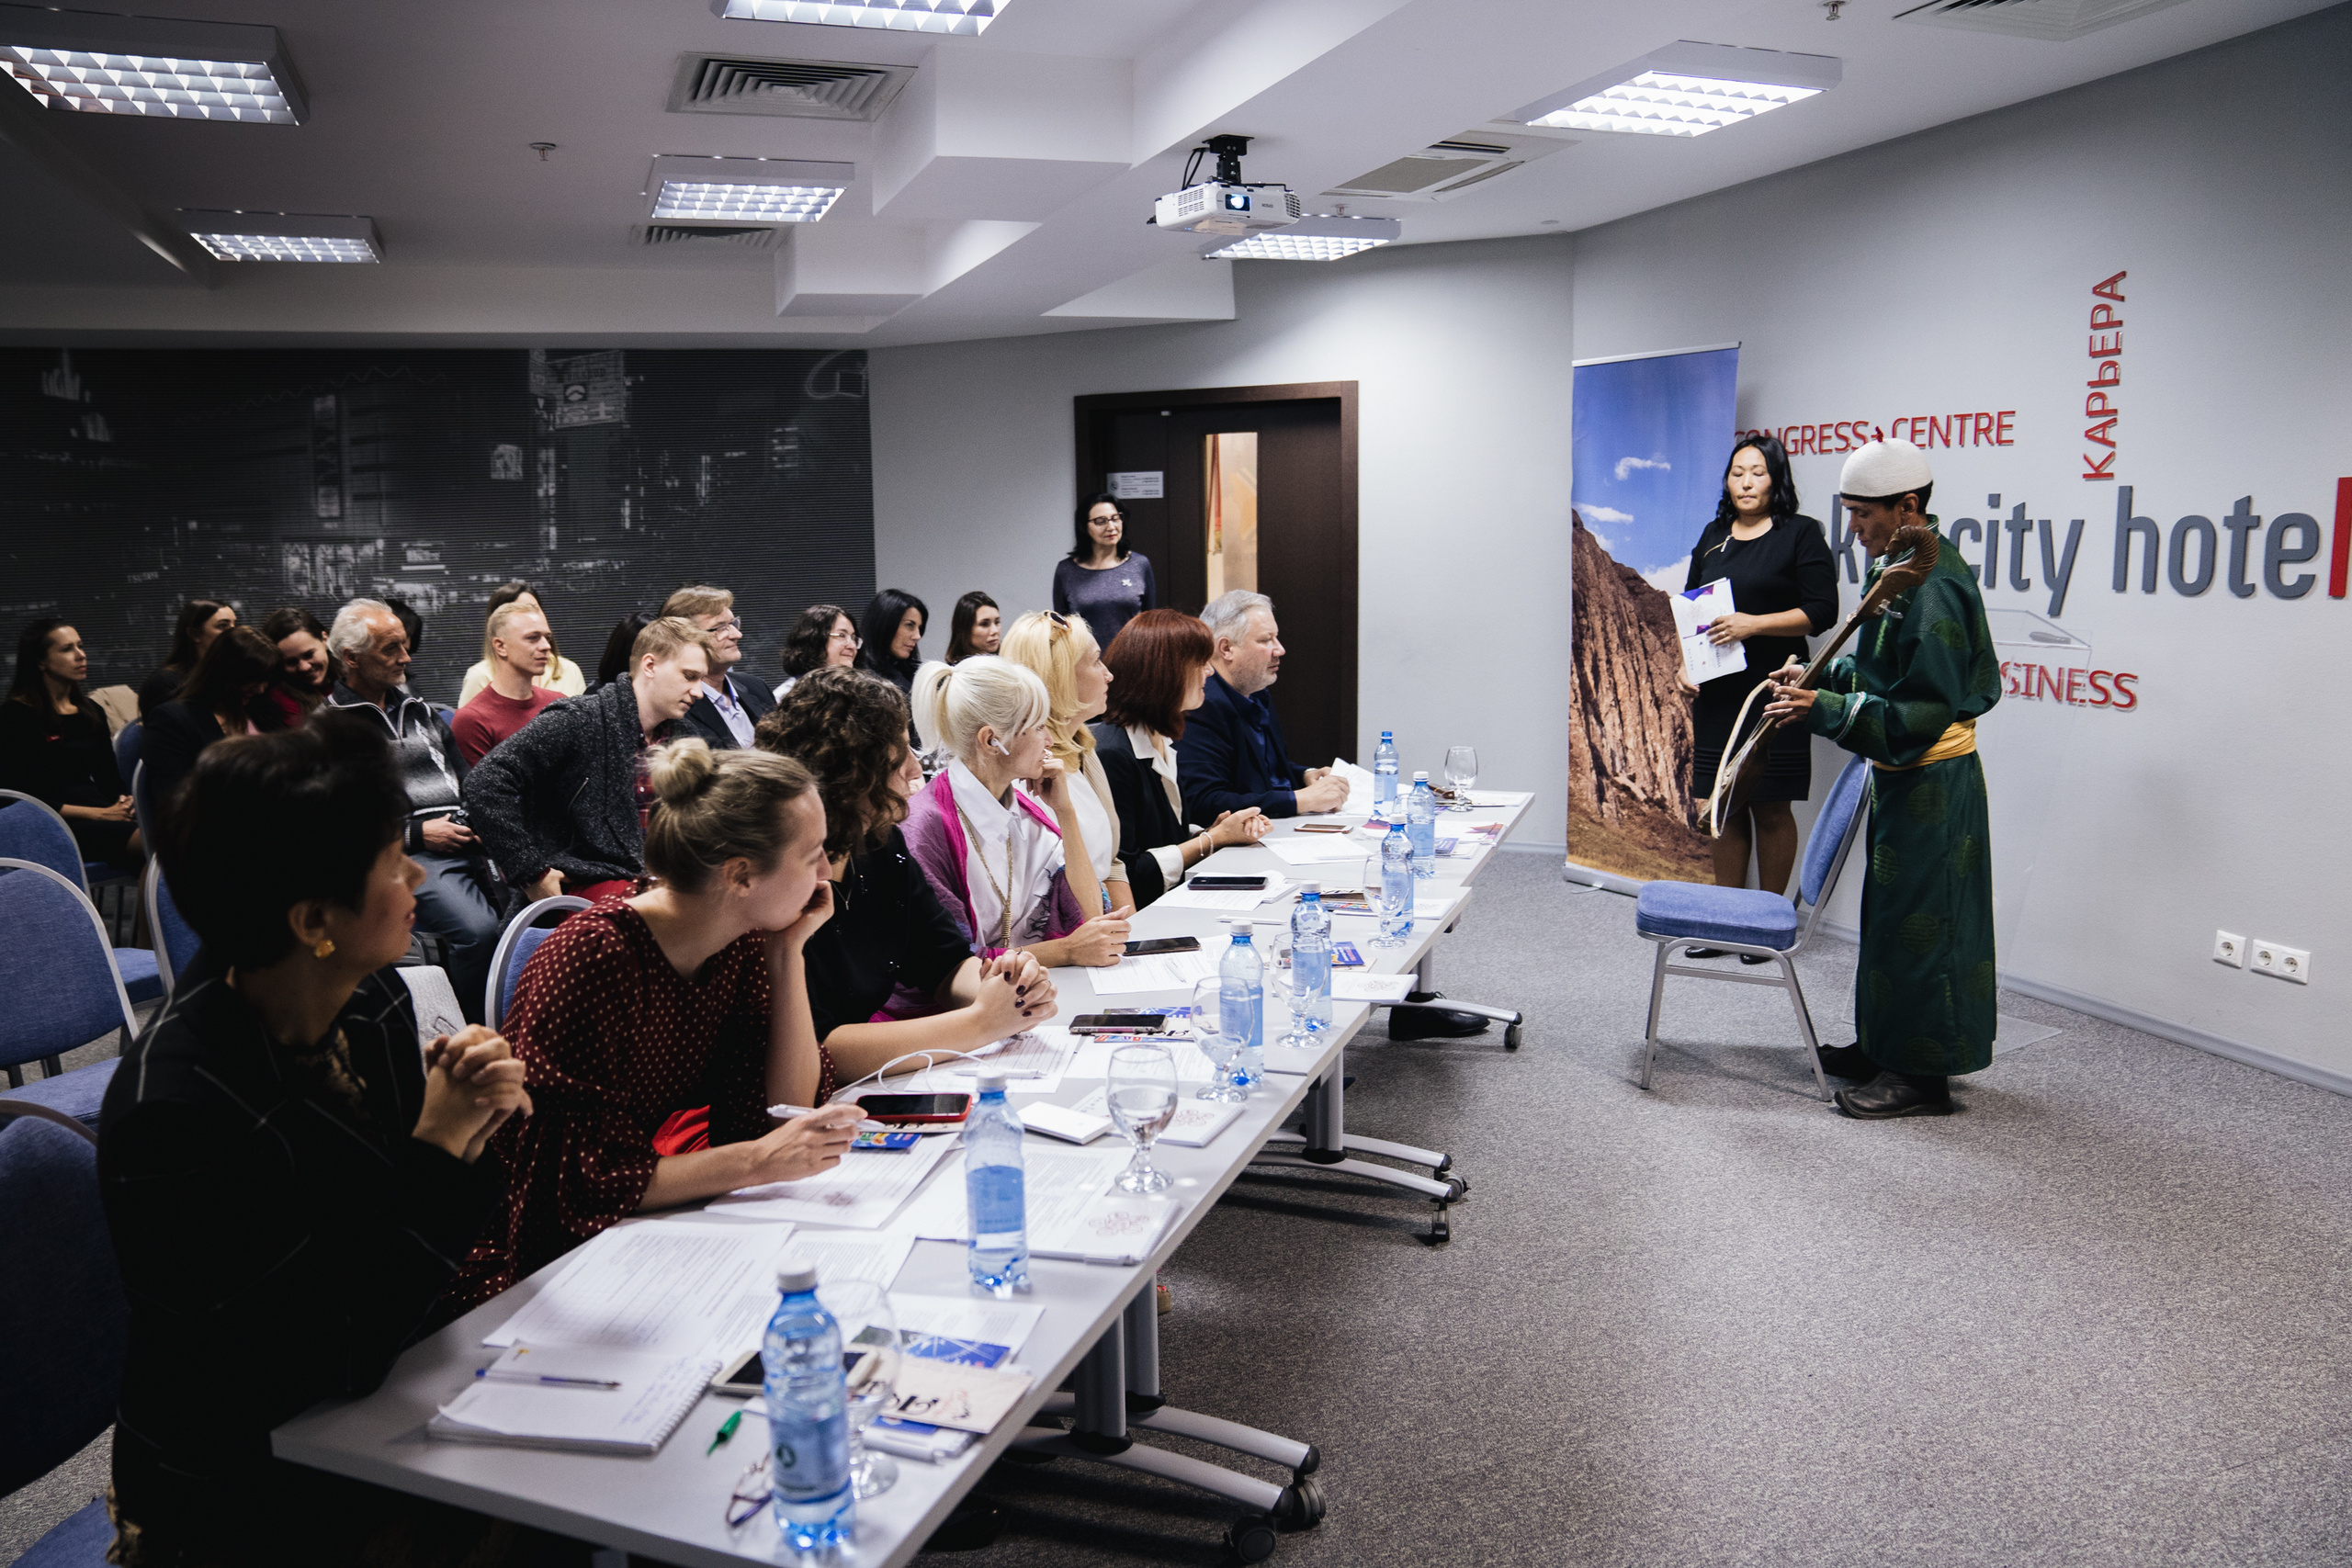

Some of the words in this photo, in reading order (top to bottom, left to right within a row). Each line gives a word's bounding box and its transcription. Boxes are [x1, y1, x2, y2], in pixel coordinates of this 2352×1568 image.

[2083, 270, 2127, 481] КАРЬЕРА
[1949, 493, 2085, 618] city
[2112, 477, 2352, 601] hotel
[2000, 661, 2139, 712] SINESS
